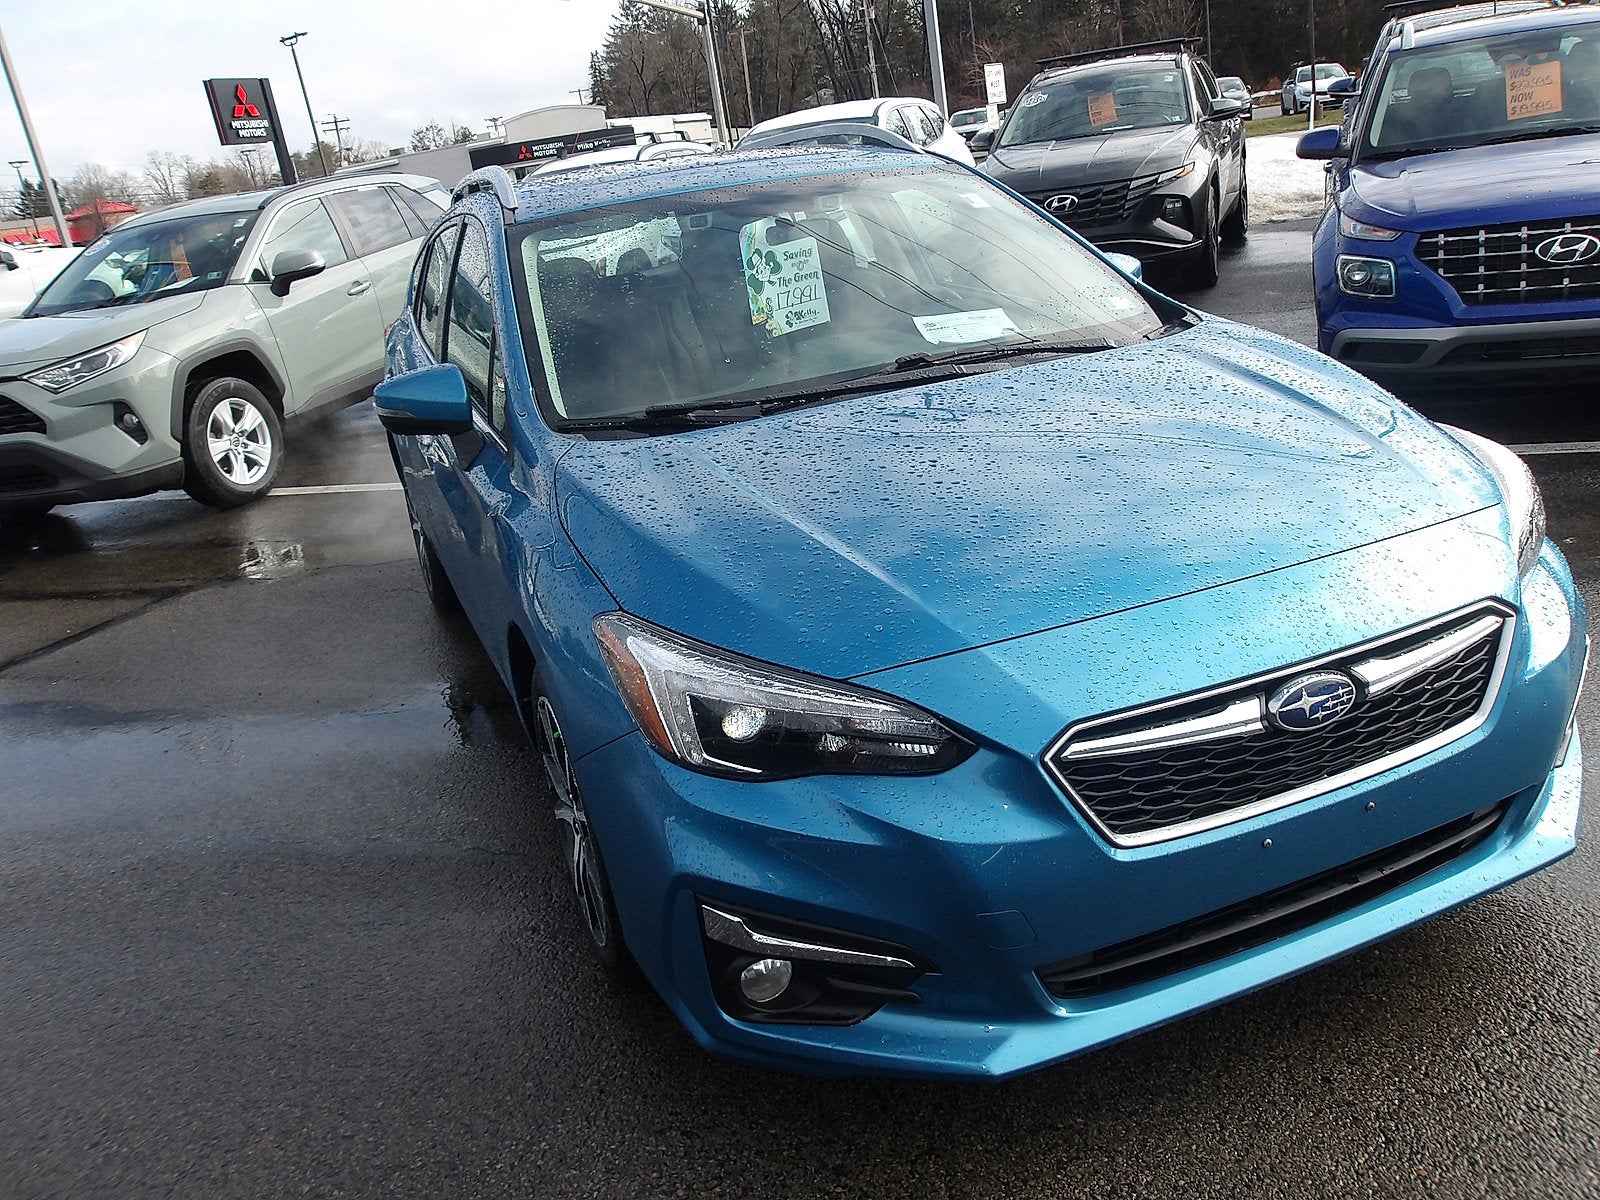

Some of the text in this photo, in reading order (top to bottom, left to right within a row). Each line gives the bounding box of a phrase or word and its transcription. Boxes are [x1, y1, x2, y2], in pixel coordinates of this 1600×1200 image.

[1510, 67, 1532, 79] WAS
[1510, 91, 1534, 103] NOW
[231, 120, 269, 129] MITSUBISHI
[238, 128, 267, 138] MOTORS
[531, 141, 564, 151] MITSUBISHI
[577, 142, 594, 151] Mike
[533, 149, 558, 158] MOTORS
[783, 247, 813, 261] Saving
[776, 271, 820, 288] The Green
